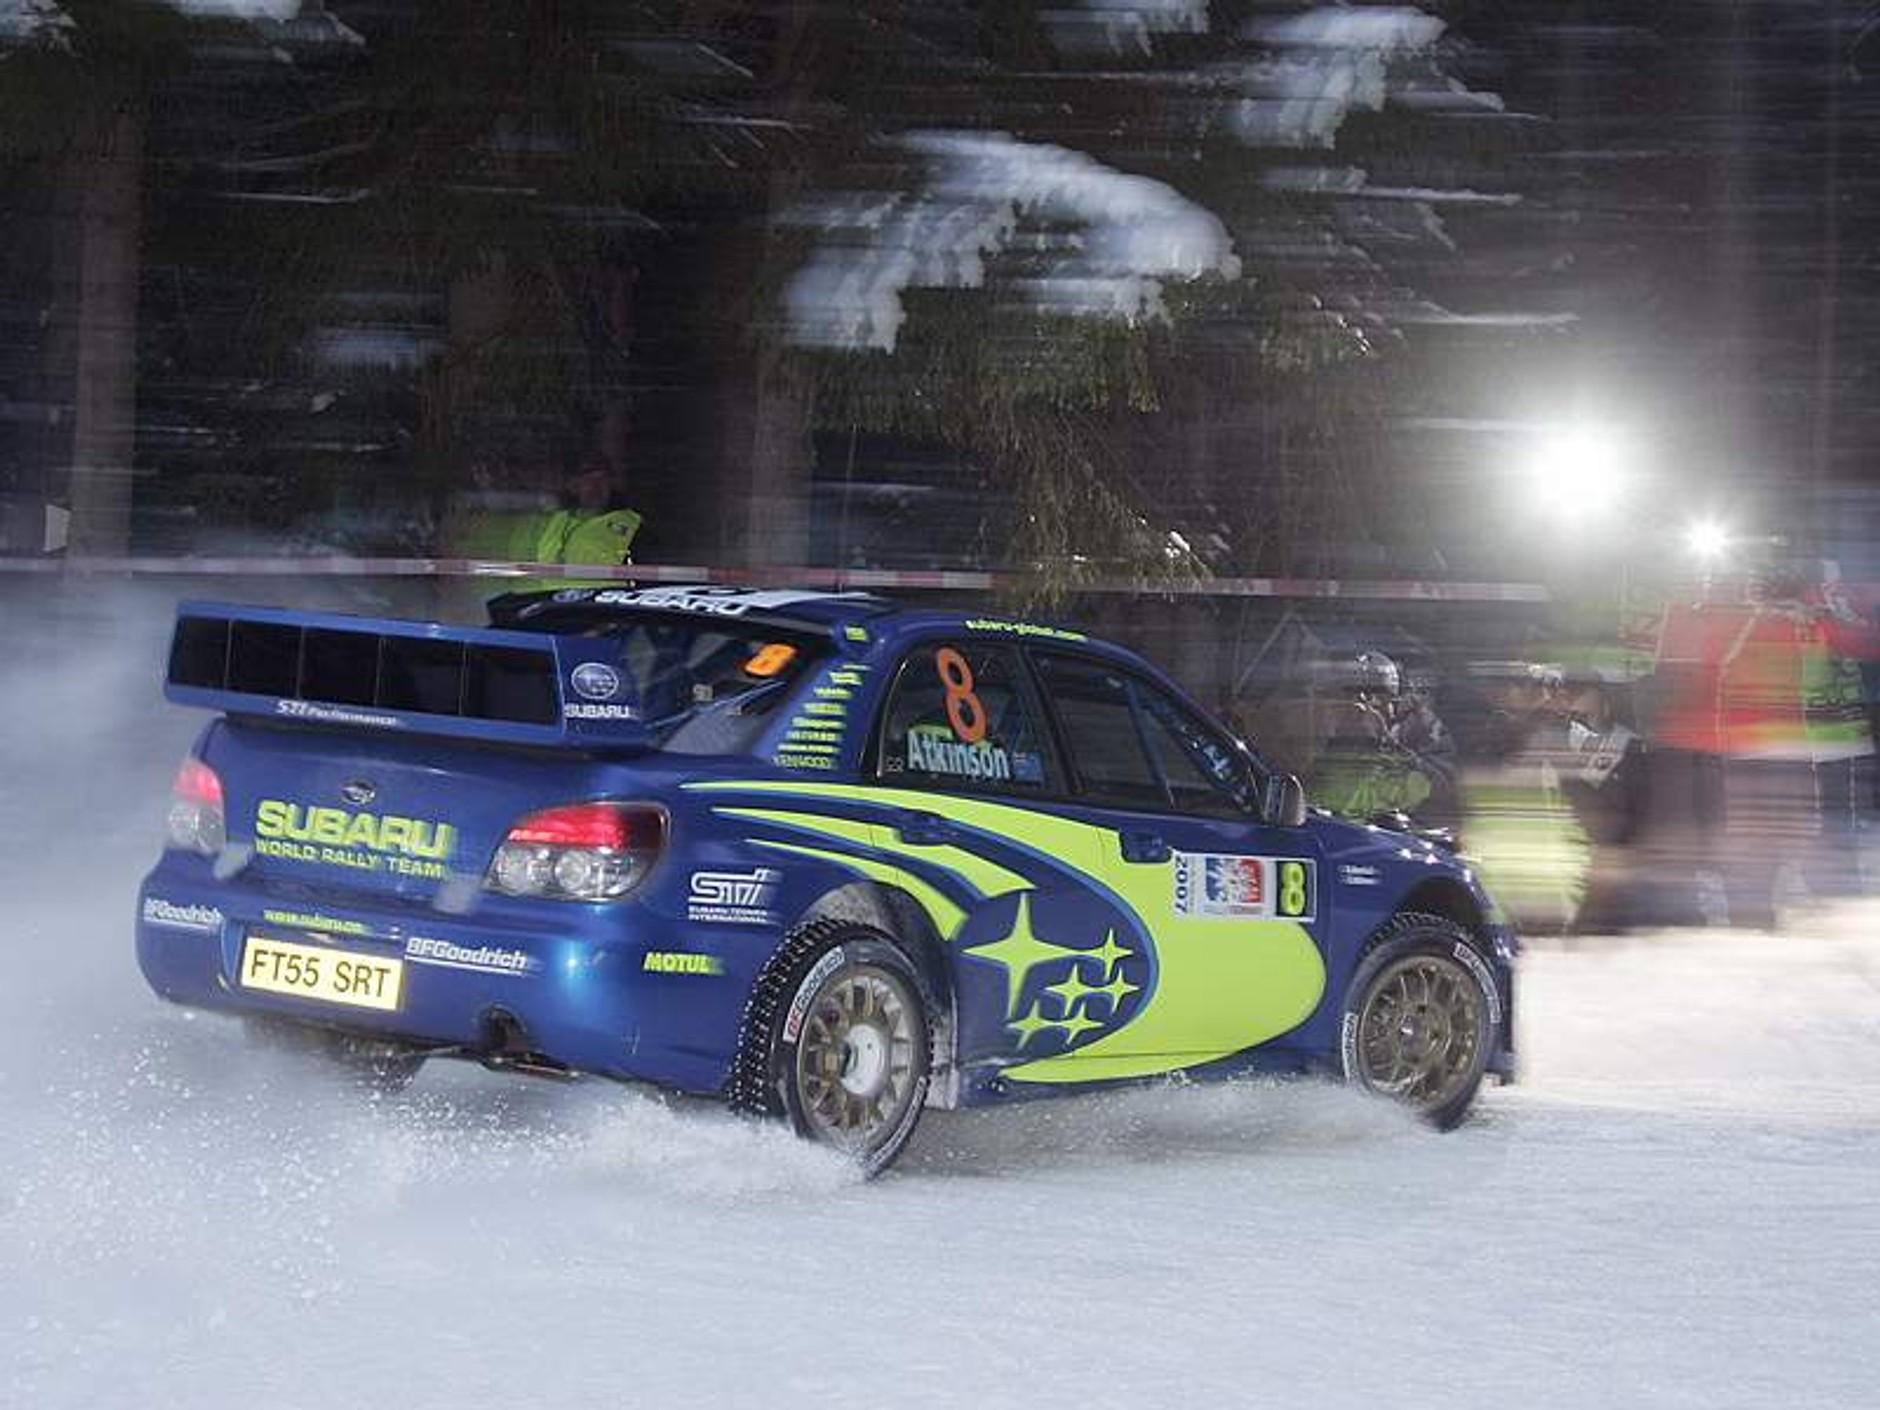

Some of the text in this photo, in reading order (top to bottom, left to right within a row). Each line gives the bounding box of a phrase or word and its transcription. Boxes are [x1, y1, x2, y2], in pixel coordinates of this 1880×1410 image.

[564, 703, 630, 718] SUBARU
[937, 648, 986, 742] 8
[907, 730, 1011, 780] Atkinson
[256, 800, 458, 859] SUBARU
[255, 837, 444, 881] WORLD RALLY TEAM
[1174, 854, 1190, 914] 2007
[1280, 862, 1306, 916] 8
[250, 948, 392, 998] FT55 SRT
[405, 937, 528, 968] BFGoodrich
[643, 953, 716, 975] MOTUL
